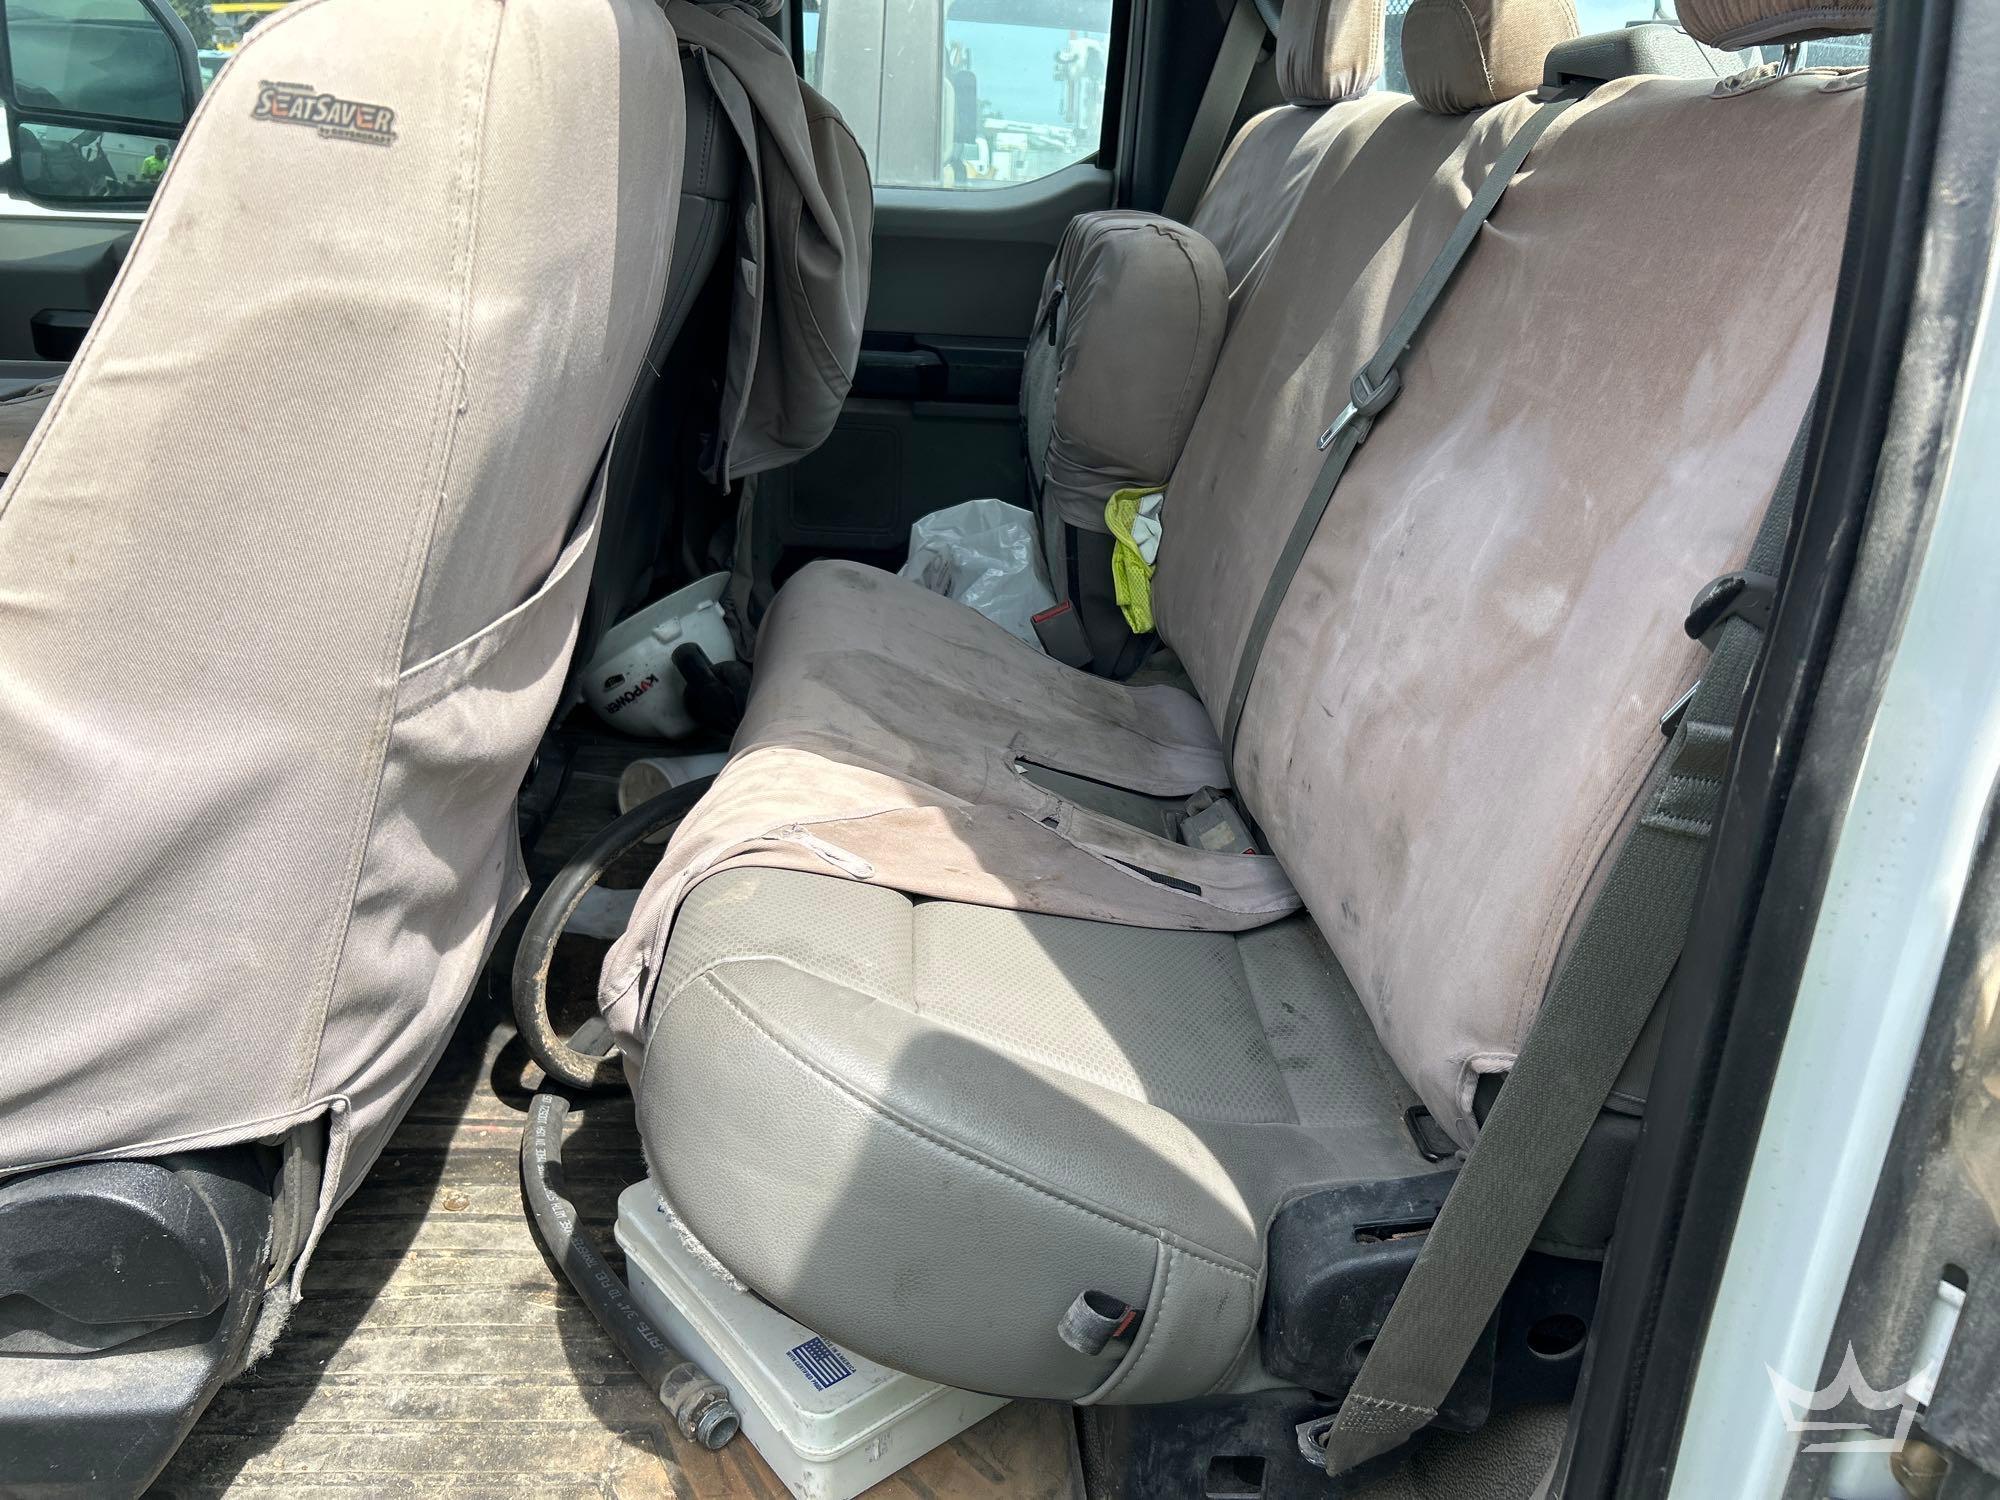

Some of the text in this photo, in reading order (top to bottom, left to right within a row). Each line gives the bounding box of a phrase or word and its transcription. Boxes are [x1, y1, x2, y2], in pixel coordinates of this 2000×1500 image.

[535, 1125, 546, 1136] USA
[535, 1148, 547, 1163] MADE
[835, 1352, 857, 1373] AMERICA
